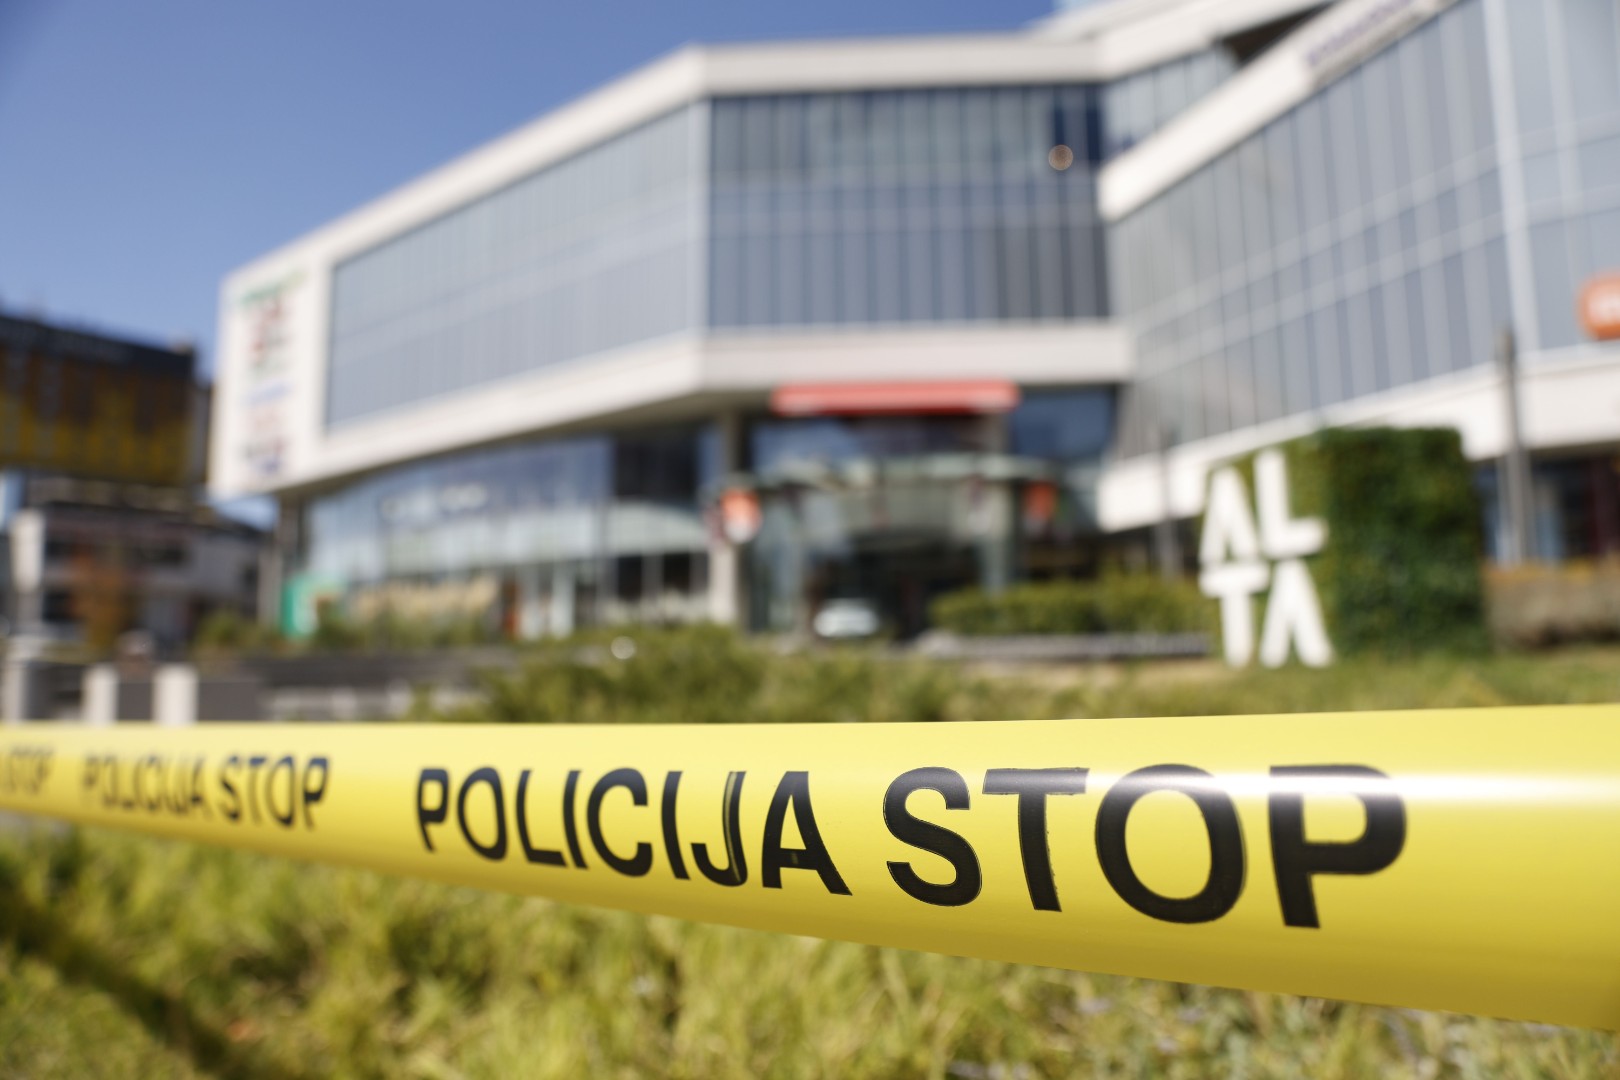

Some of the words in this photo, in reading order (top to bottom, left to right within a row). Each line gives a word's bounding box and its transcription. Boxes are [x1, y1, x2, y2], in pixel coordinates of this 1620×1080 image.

[219, 755, 329, 831] STOP
[416, 767, 853, 896] POLICIJA
[883, 763, 1408, 929] STOP
